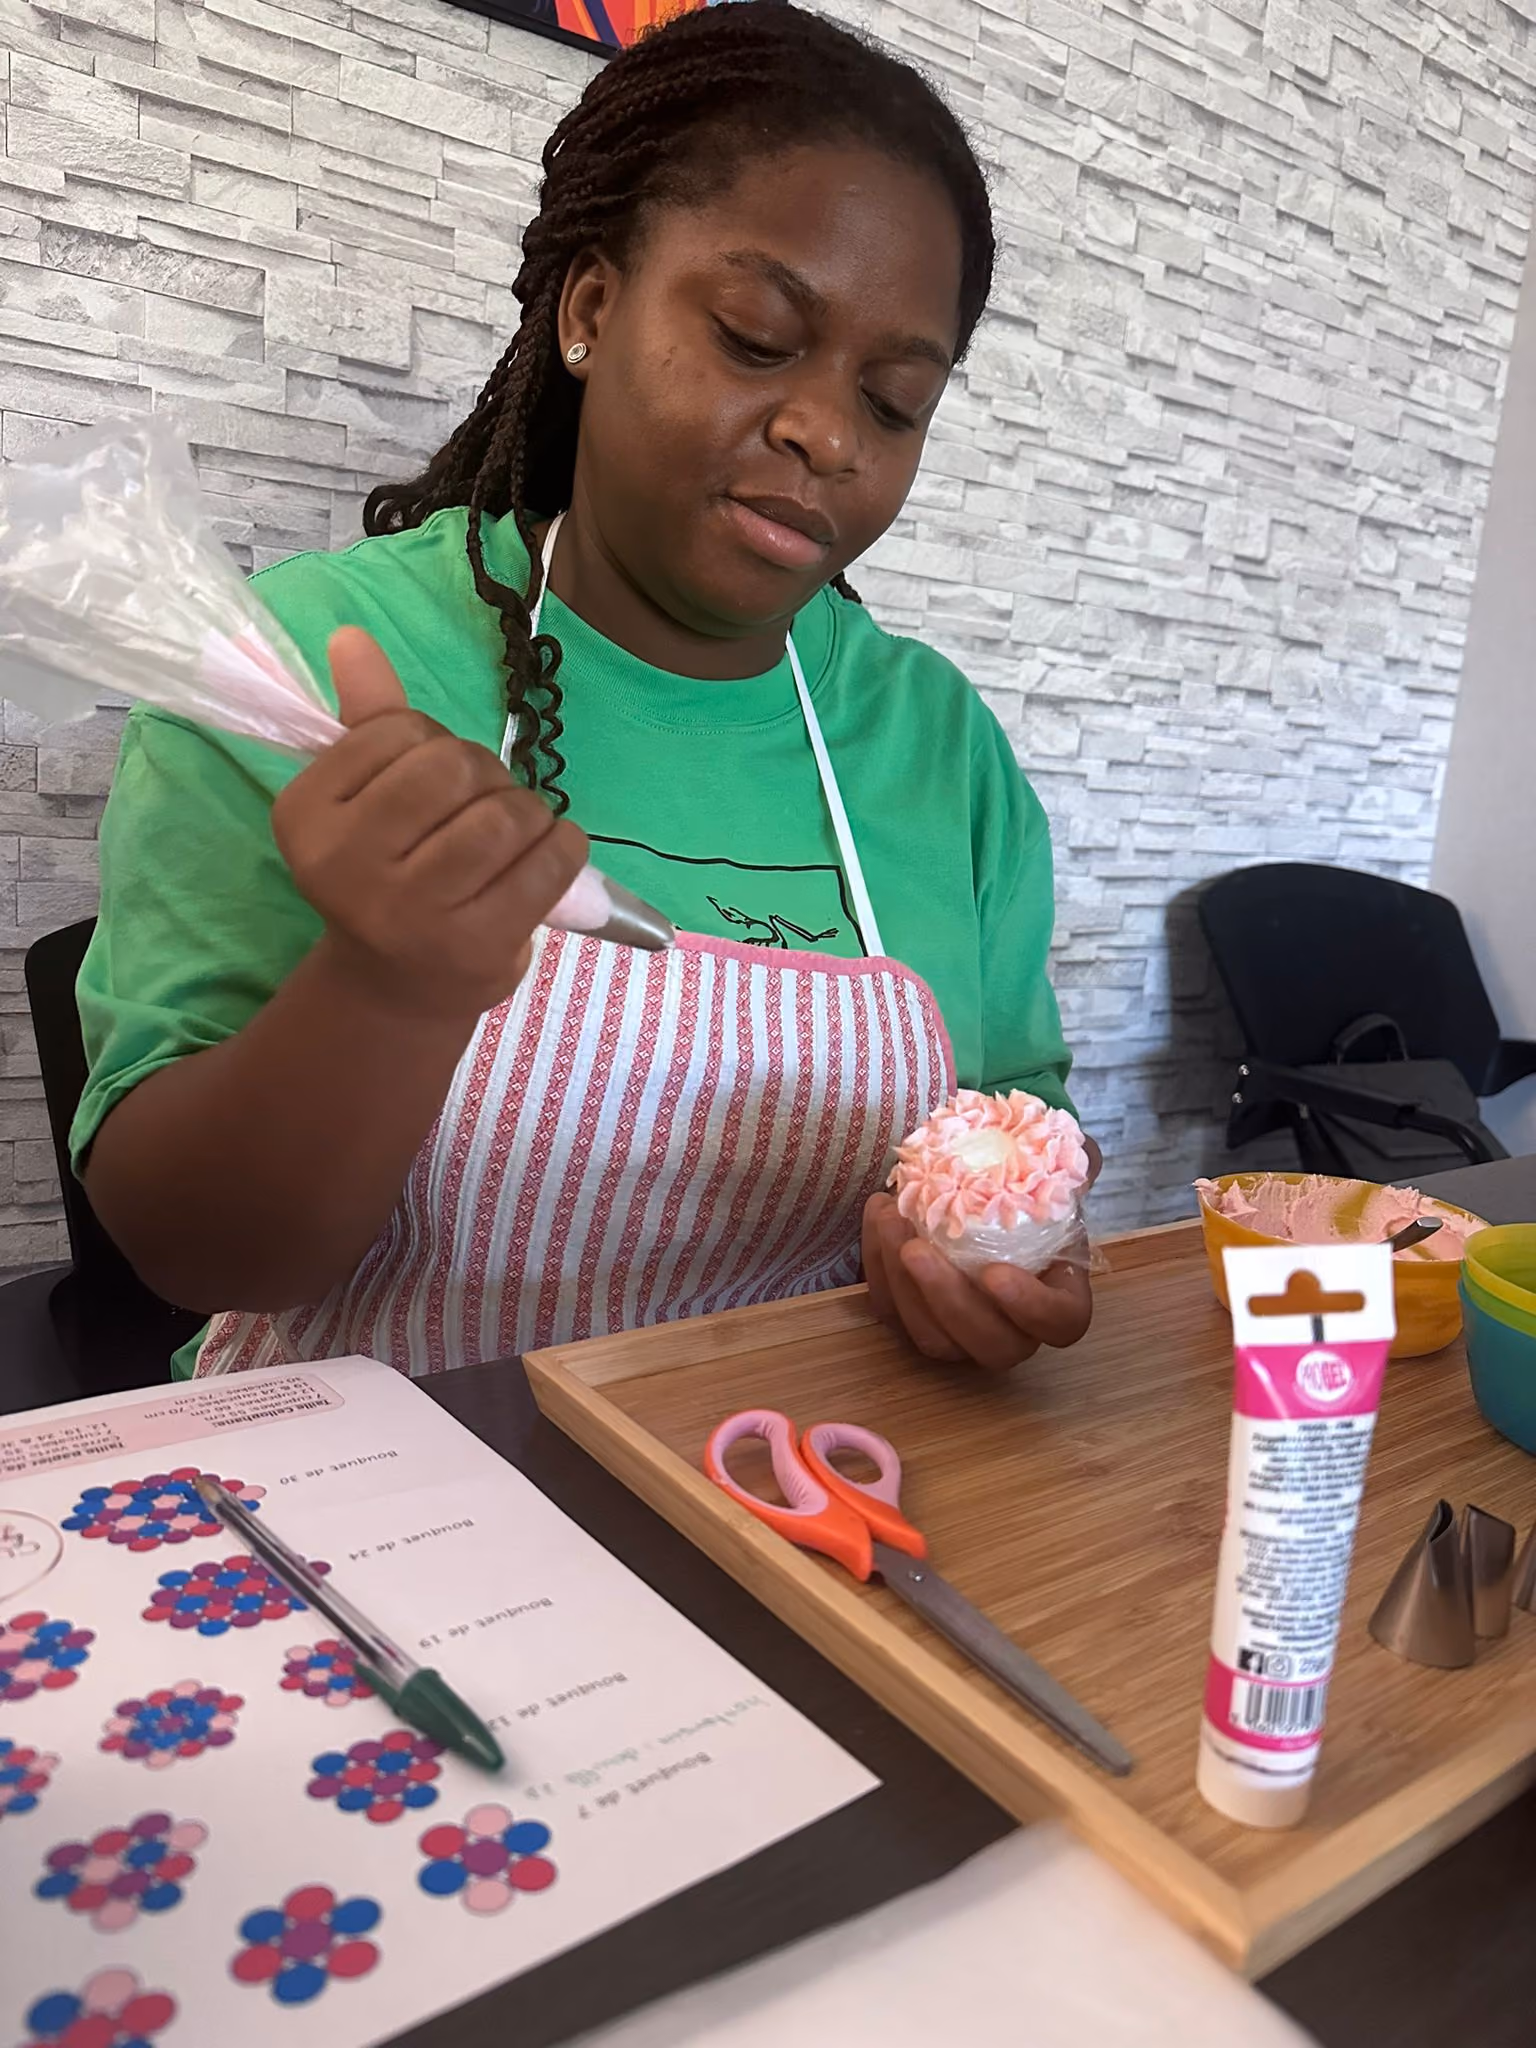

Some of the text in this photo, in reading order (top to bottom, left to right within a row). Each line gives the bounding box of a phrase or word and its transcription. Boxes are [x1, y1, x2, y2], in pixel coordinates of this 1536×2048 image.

[144, 1411, 165, 1419] cm
[204, 1413, 226, 1421] cm
[211, 1399, 331, 1428] Taille Cellophane:
[248, 1395, 312, 1411] cupcakes:
[85, 1441, 124, 1454] Taille
[279, 1450, 398, 1485] Bouquet de 30
[349, 1518, 474, 1561] Bouquet de 24
[419, 1597, 554, 1649] Bouquet de 19
[488, 1671, 628, 1732] Bouquet de 12
[626, 1751, 712, 1795] Bouquet
[596, 1789, 621, 1809] de
